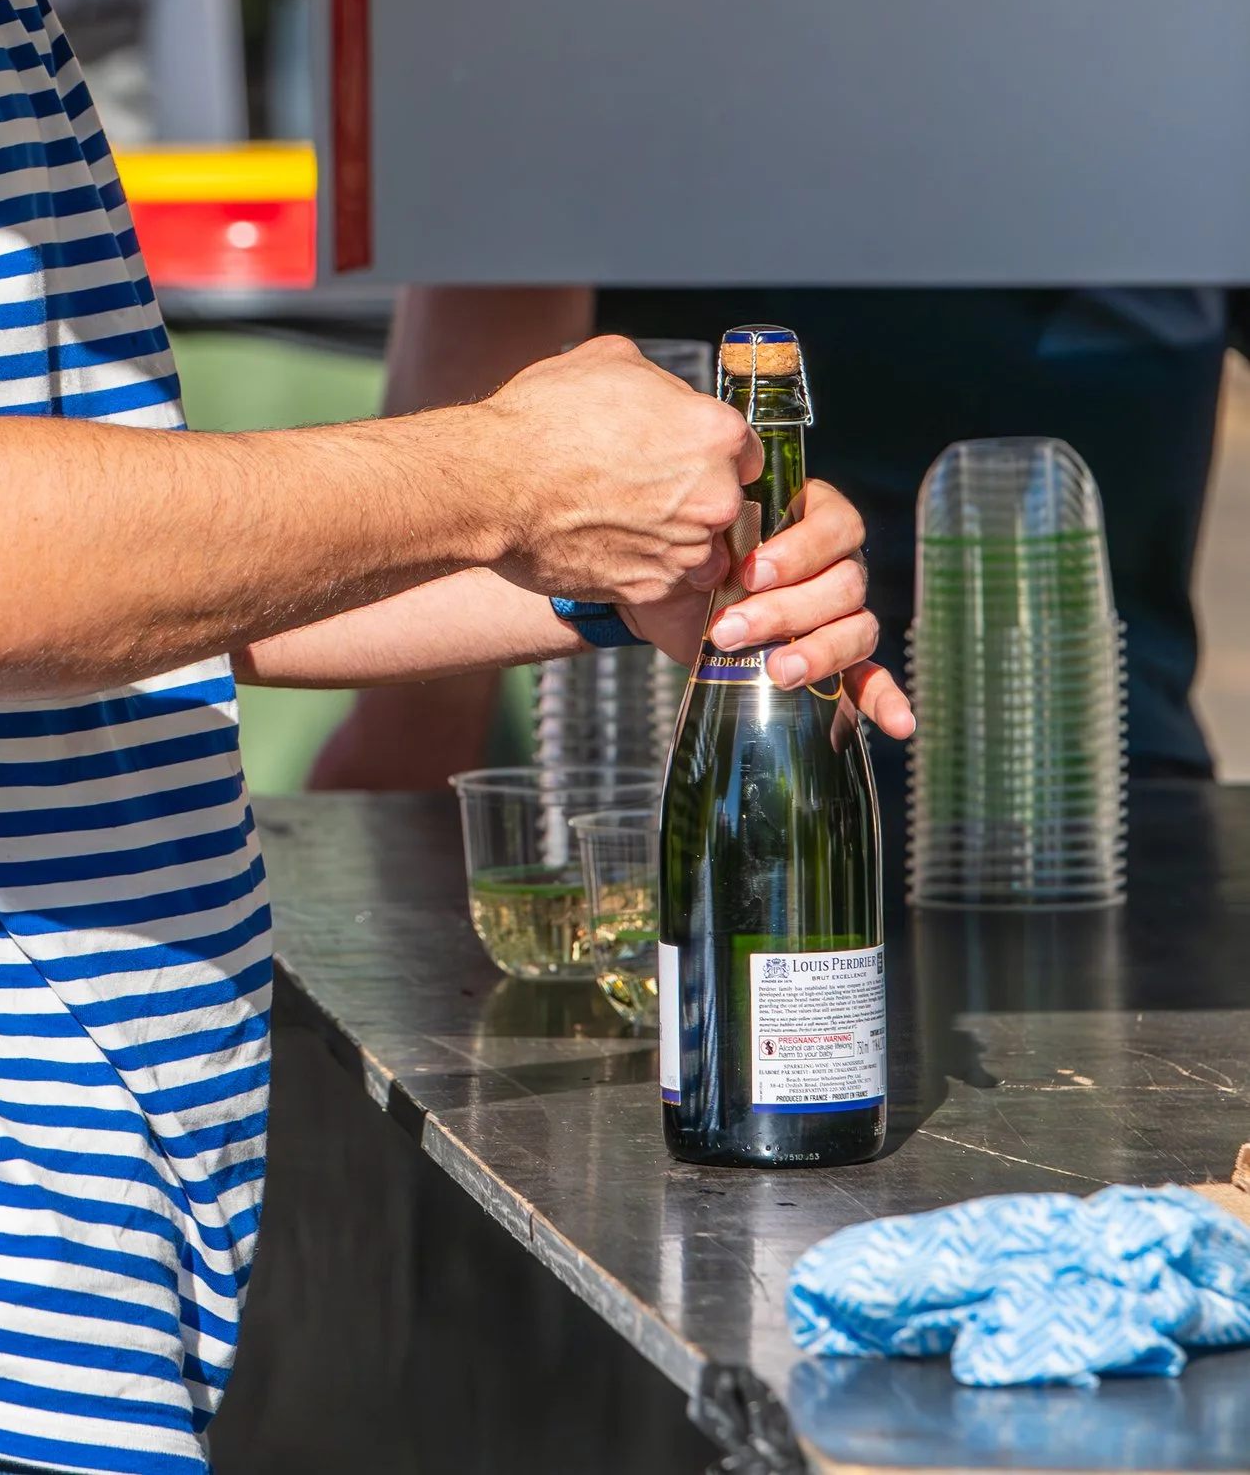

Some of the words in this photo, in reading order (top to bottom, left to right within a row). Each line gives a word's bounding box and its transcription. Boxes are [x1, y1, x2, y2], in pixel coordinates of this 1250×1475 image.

[700, 653, 762, 668] PERDRIER
[793, 959, 829, 972] LOUIS
[831, 955, 877, 971] PERDRIER
[832, 972, 867, 980] EXCELLENCE
[823, 1034, 852, 1042] WARNING
[834, 1042, 853, 1051] lifelong
[804, 1052, 817, 1060] your
[818, 1050, 833, 1059] baby
[832, 1092, 849, 1100] PRODUIT
[855, 1090, 868, 1098] FRANCE
